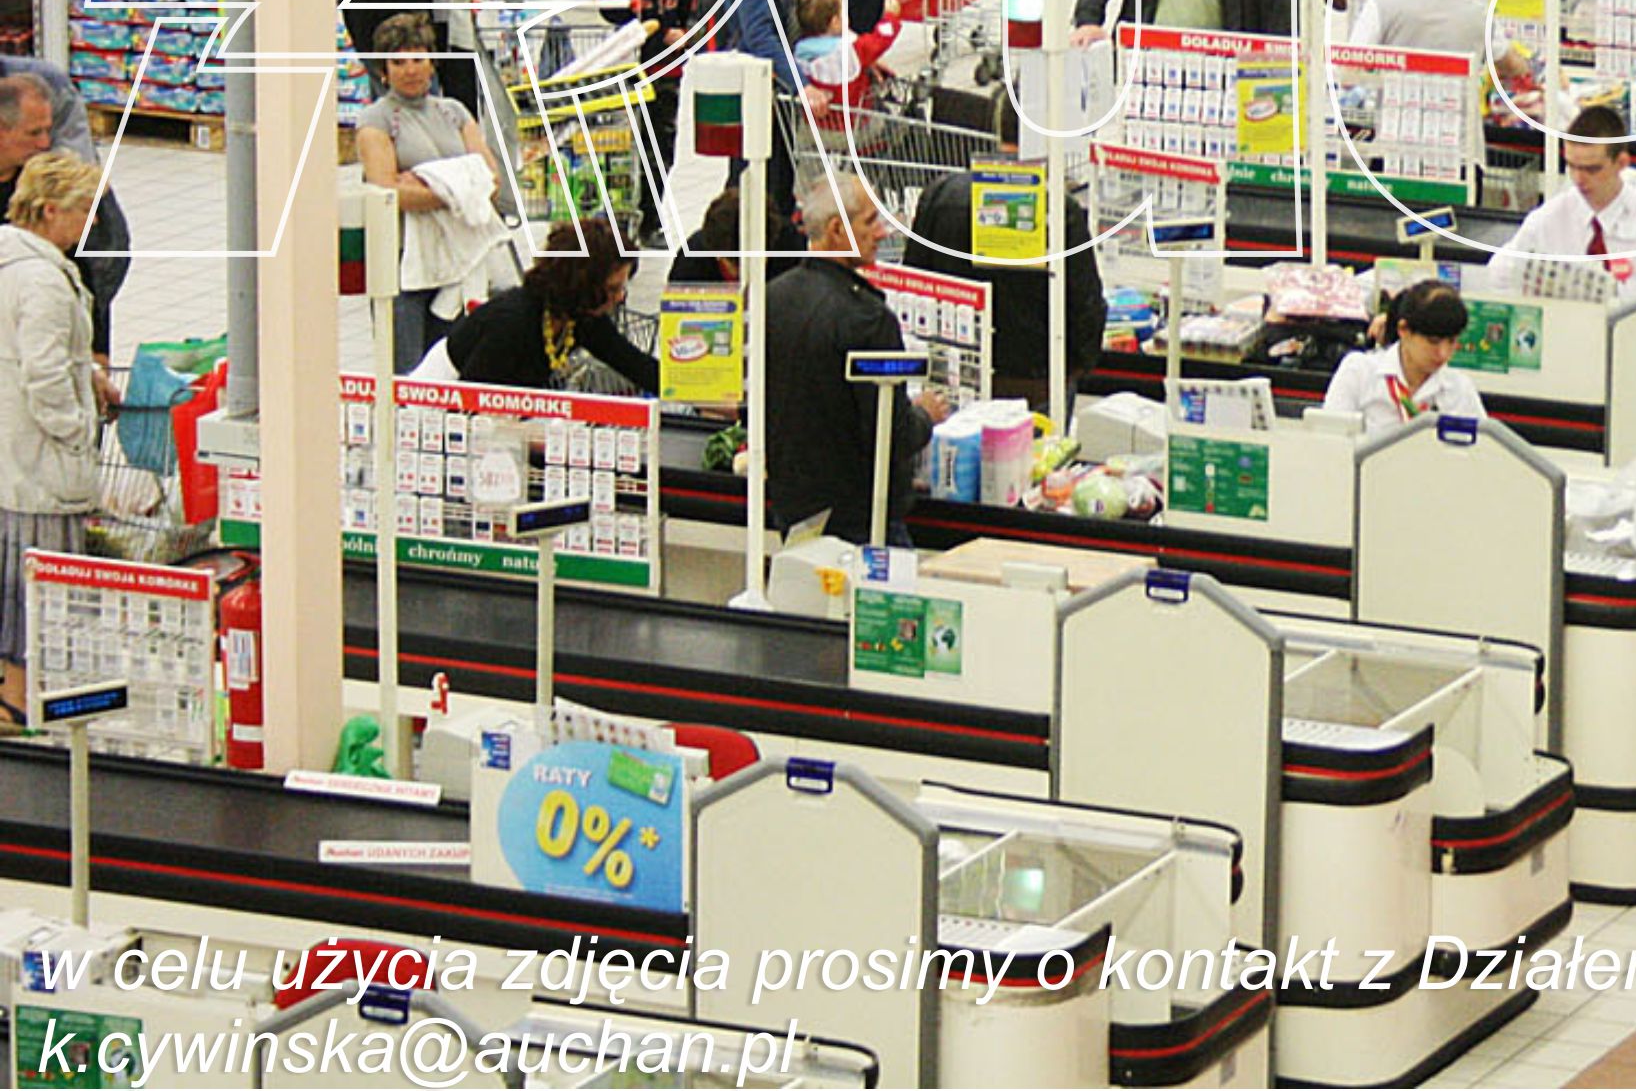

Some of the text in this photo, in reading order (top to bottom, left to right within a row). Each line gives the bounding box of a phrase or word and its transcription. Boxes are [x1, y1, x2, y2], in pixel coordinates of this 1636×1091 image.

[1180, 34, 1407, 69] DOŁADUJ KOMÓRKĘ
[397, 384, 463, 409] SWOJĄ
[478, 389, 572, 419] KOMÓRKĘ
[408, 543, 483, 567] chrońmy
[533, 763, 592, 789] RATY
[367, 848, 427, 860] UDANYCH
